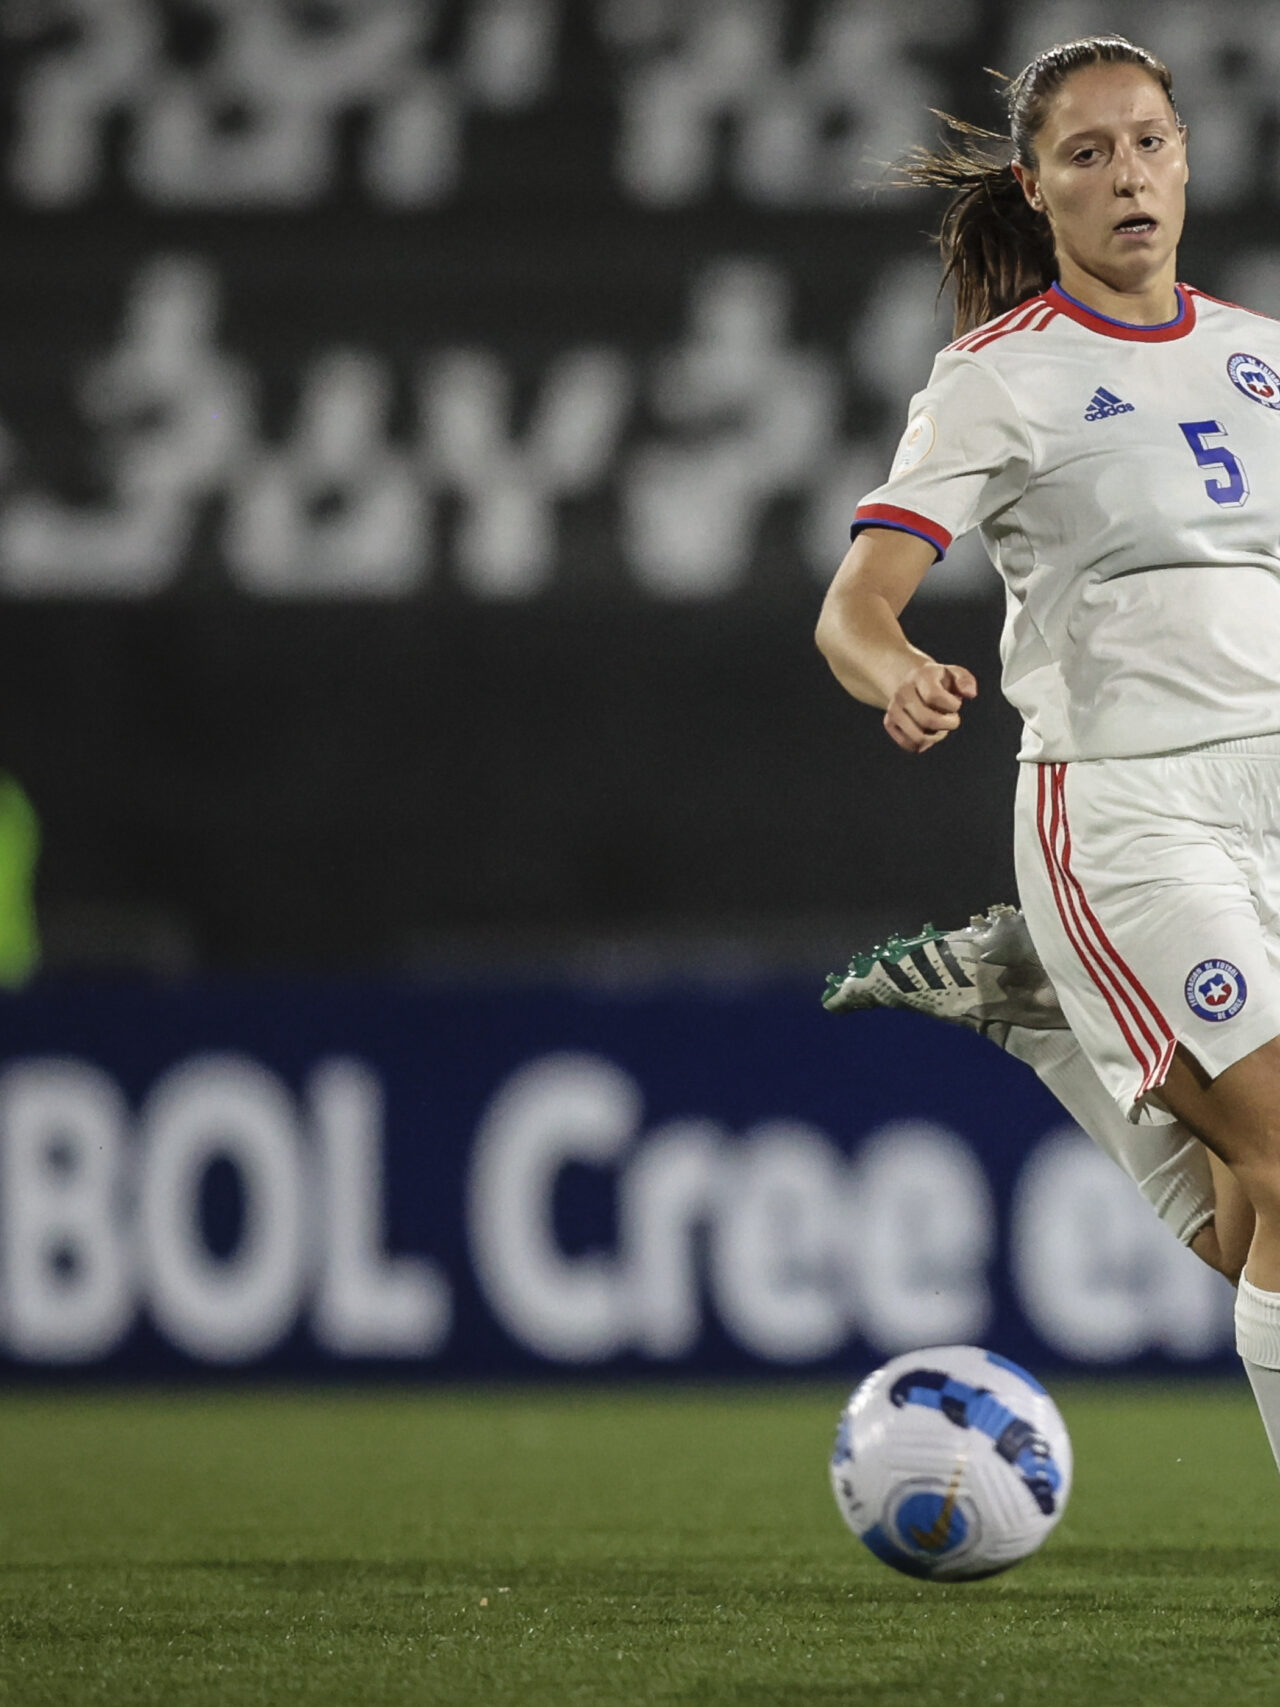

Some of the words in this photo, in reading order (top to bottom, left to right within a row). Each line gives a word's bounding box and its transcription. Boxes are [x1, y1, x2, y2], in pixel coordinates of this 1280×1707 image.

[1084, 403, 1135, 422] adidas
[1178, 420, 1250, 508] 5
[468, 1053, 992, 1362] Cree
